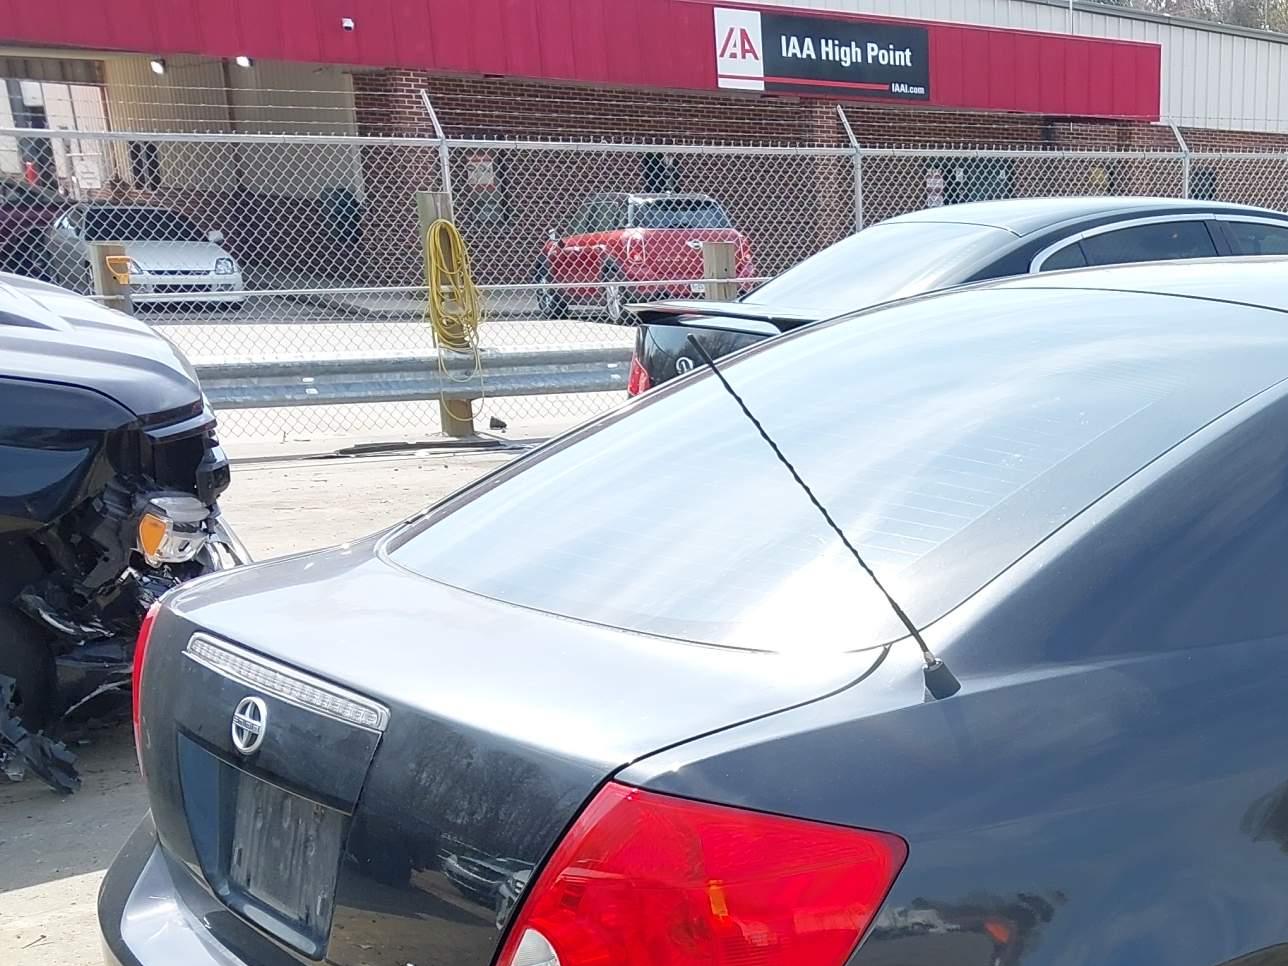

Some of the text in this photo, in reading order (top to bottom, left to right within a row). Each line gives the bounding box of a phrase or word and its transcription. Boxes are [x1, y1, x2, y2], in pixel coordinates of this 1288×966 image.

[781, 35, 912, 67] IAA High Point
